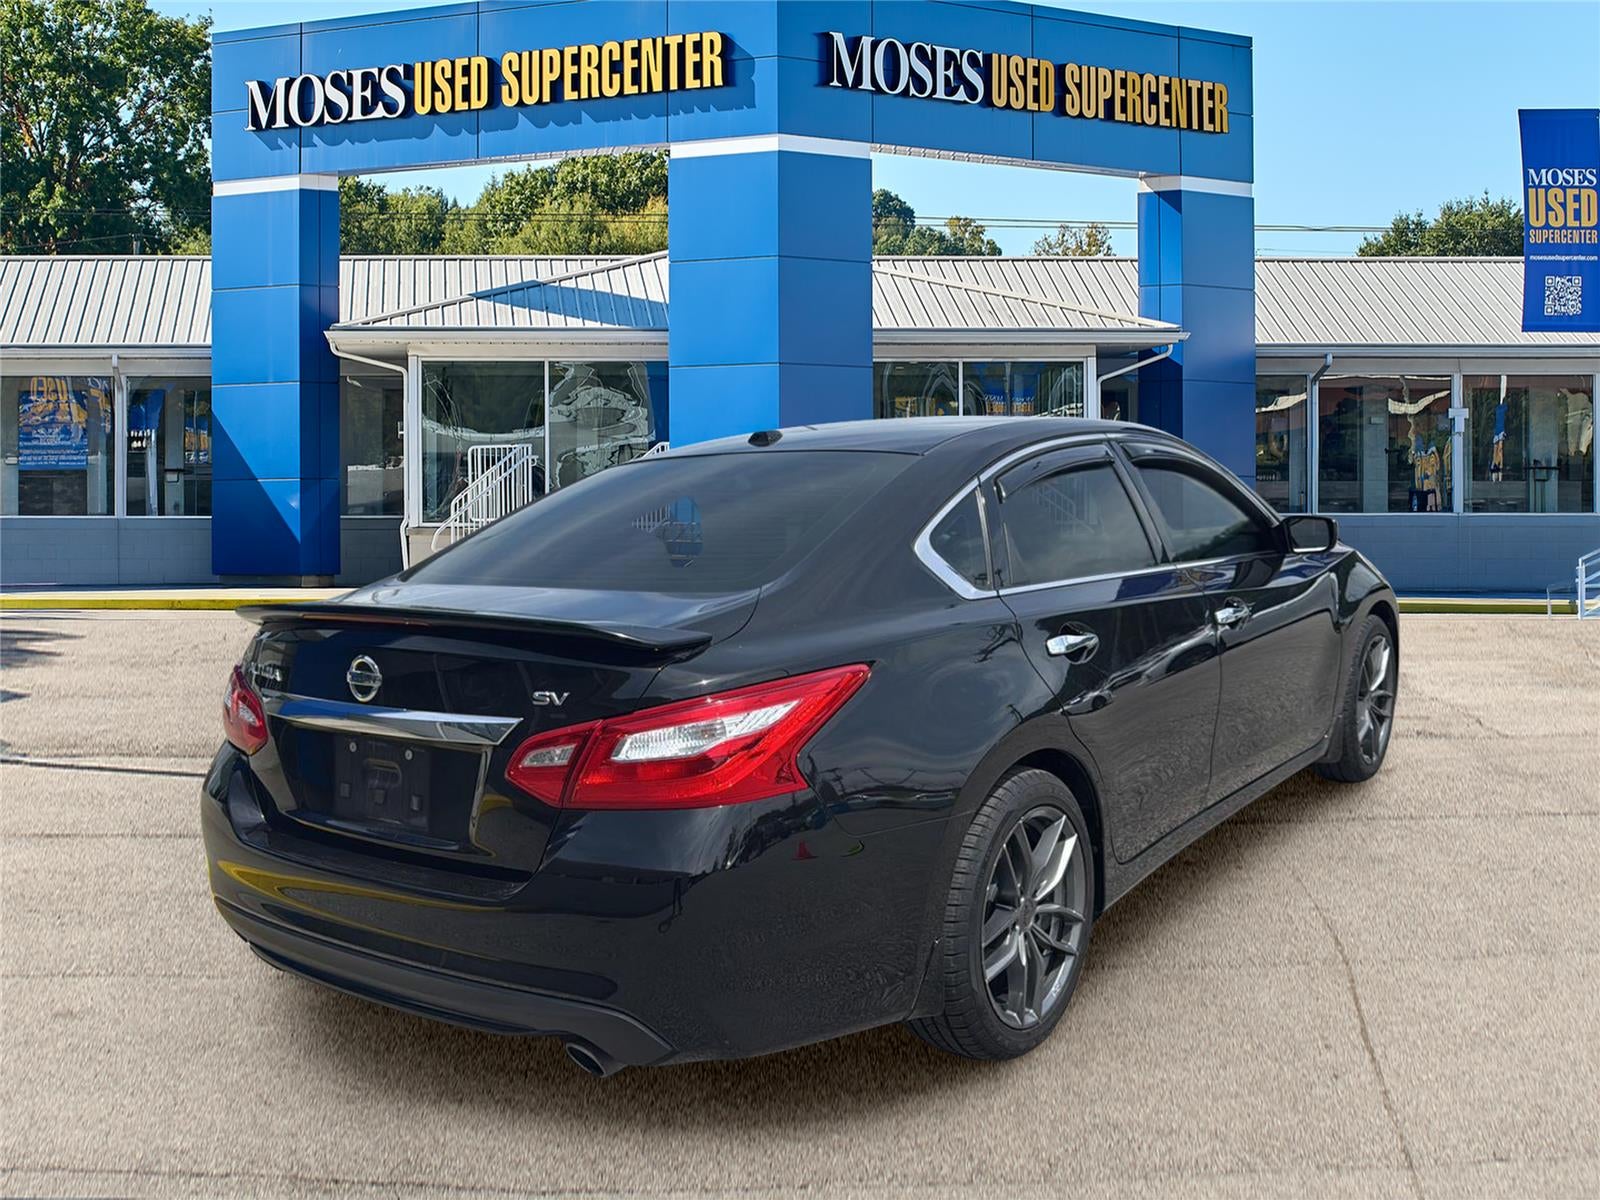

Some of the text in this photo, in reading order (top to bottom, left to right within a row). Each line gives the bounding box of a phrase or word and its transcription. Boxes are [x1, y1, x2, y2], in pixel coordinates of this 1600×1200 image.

[244, 31, 725, 131] MOSES USED SUPERCENTER
[829, 31, 1229, 134] MOSES USED SUPERCENTER
[1527, 168, 1597, 187] MOSES
[1527, 188, 1599, 228] USED
[1529, 229, 1598, 244] SUPERCENTER
[532, 691, 571, 706] SV
